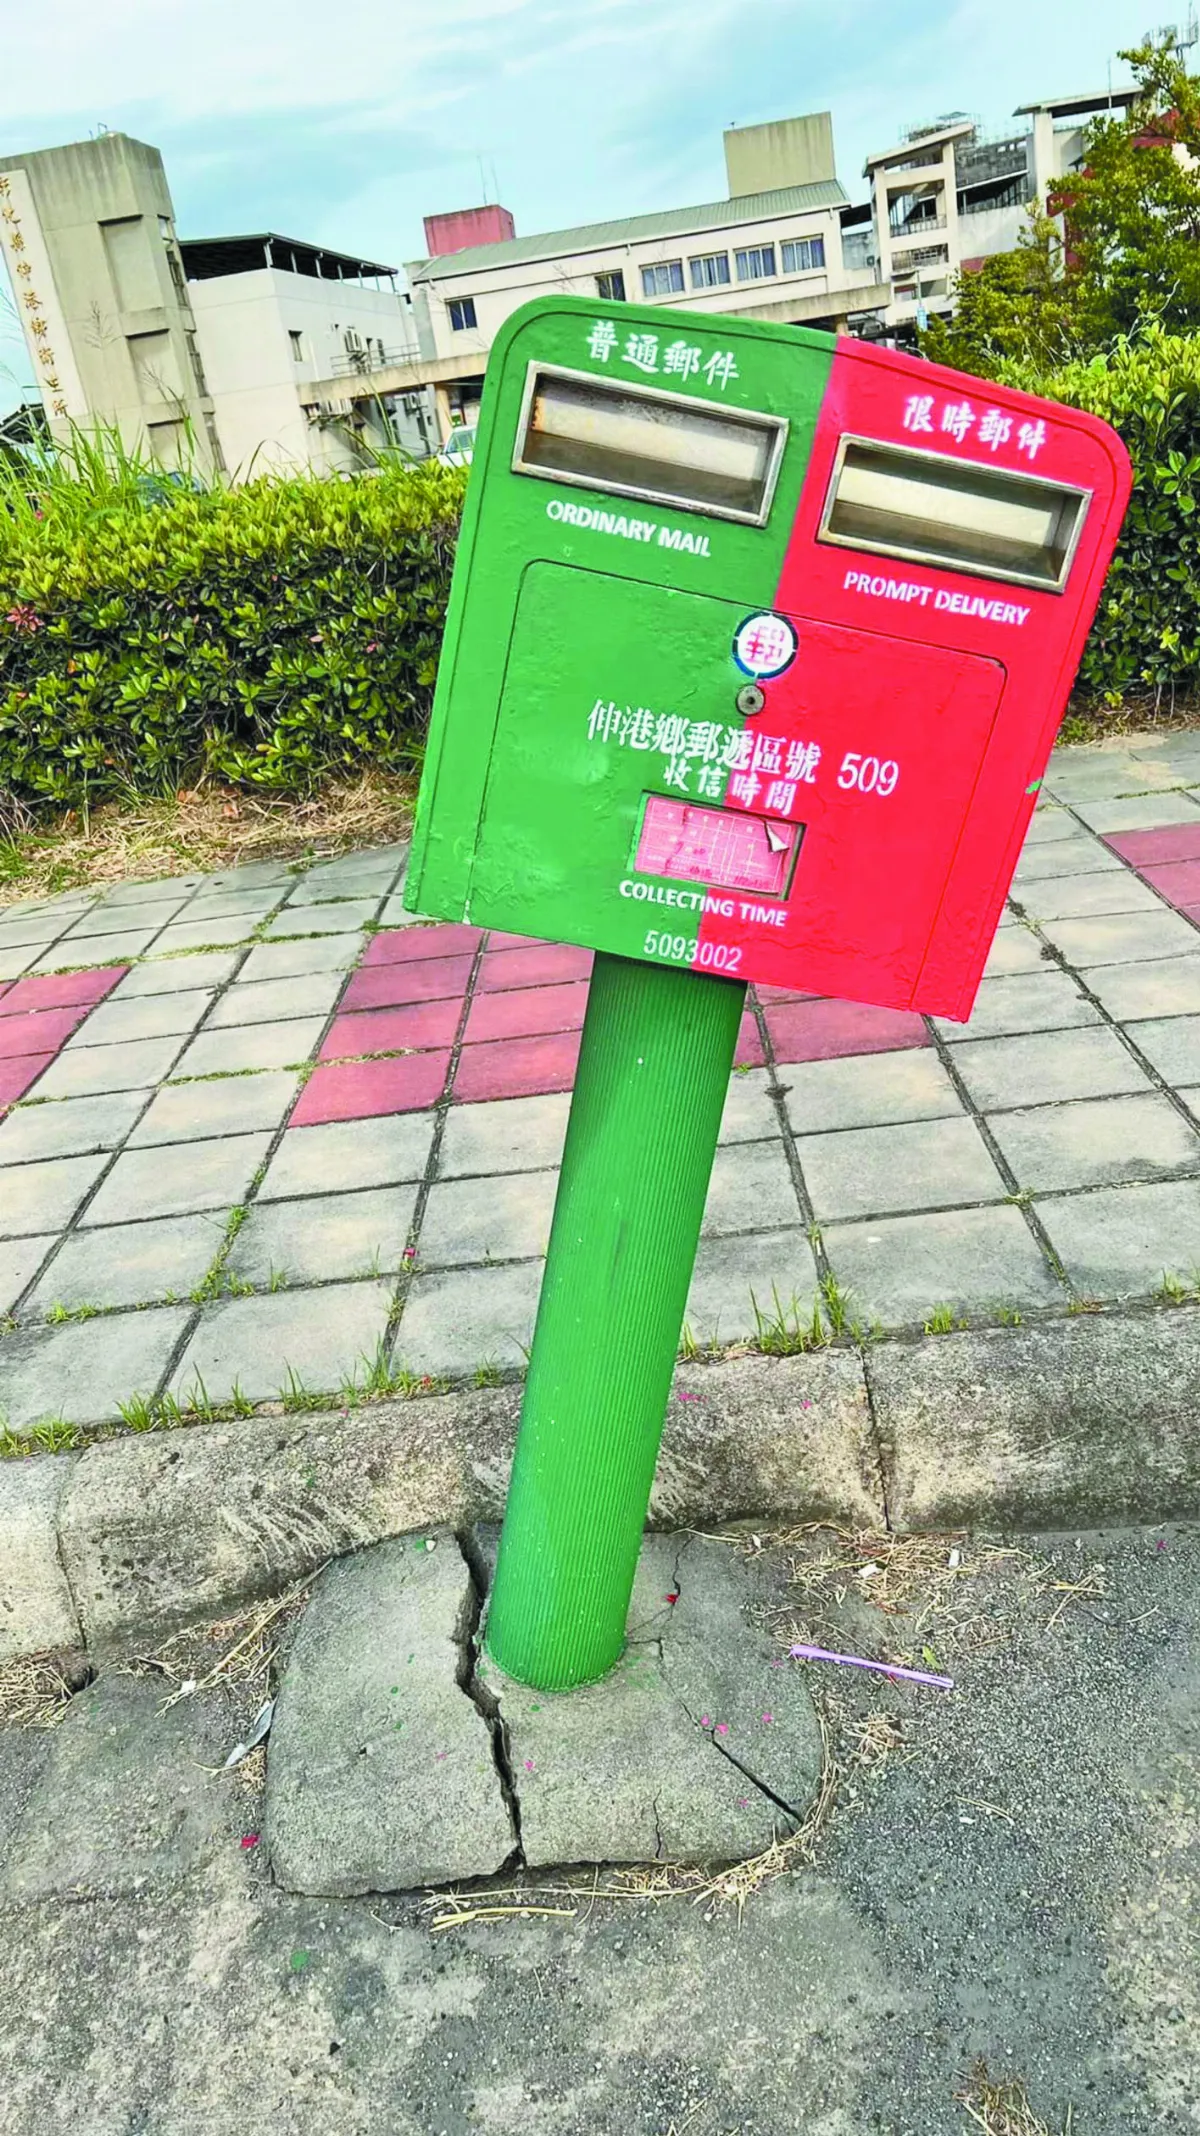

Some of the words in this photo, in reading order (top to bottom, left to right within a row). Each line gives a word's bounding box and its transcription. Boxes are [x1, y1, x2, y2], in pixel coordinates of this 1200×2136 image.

[586, 320, 741, 391] 普通郵件
[902, 395, 1047, 460] 限時郵件
[546, 500, 657, 546] ORDINARY
[657, 525, 712, 558] MAIL
[843, 570, 932, 607] PROMPT
[934, 590, 1030, 627] DELIVERY
[587, 699, 822, 784] 伸港鄉郵遞區號
[837, 752, 900, 797] 509
[663, 758, 797, 816] 收信時間
[619, 879, 734, 918] COLLECTING
[739, 902, 788, 928] TIME
[643, 930, 742, 971] 5093002
